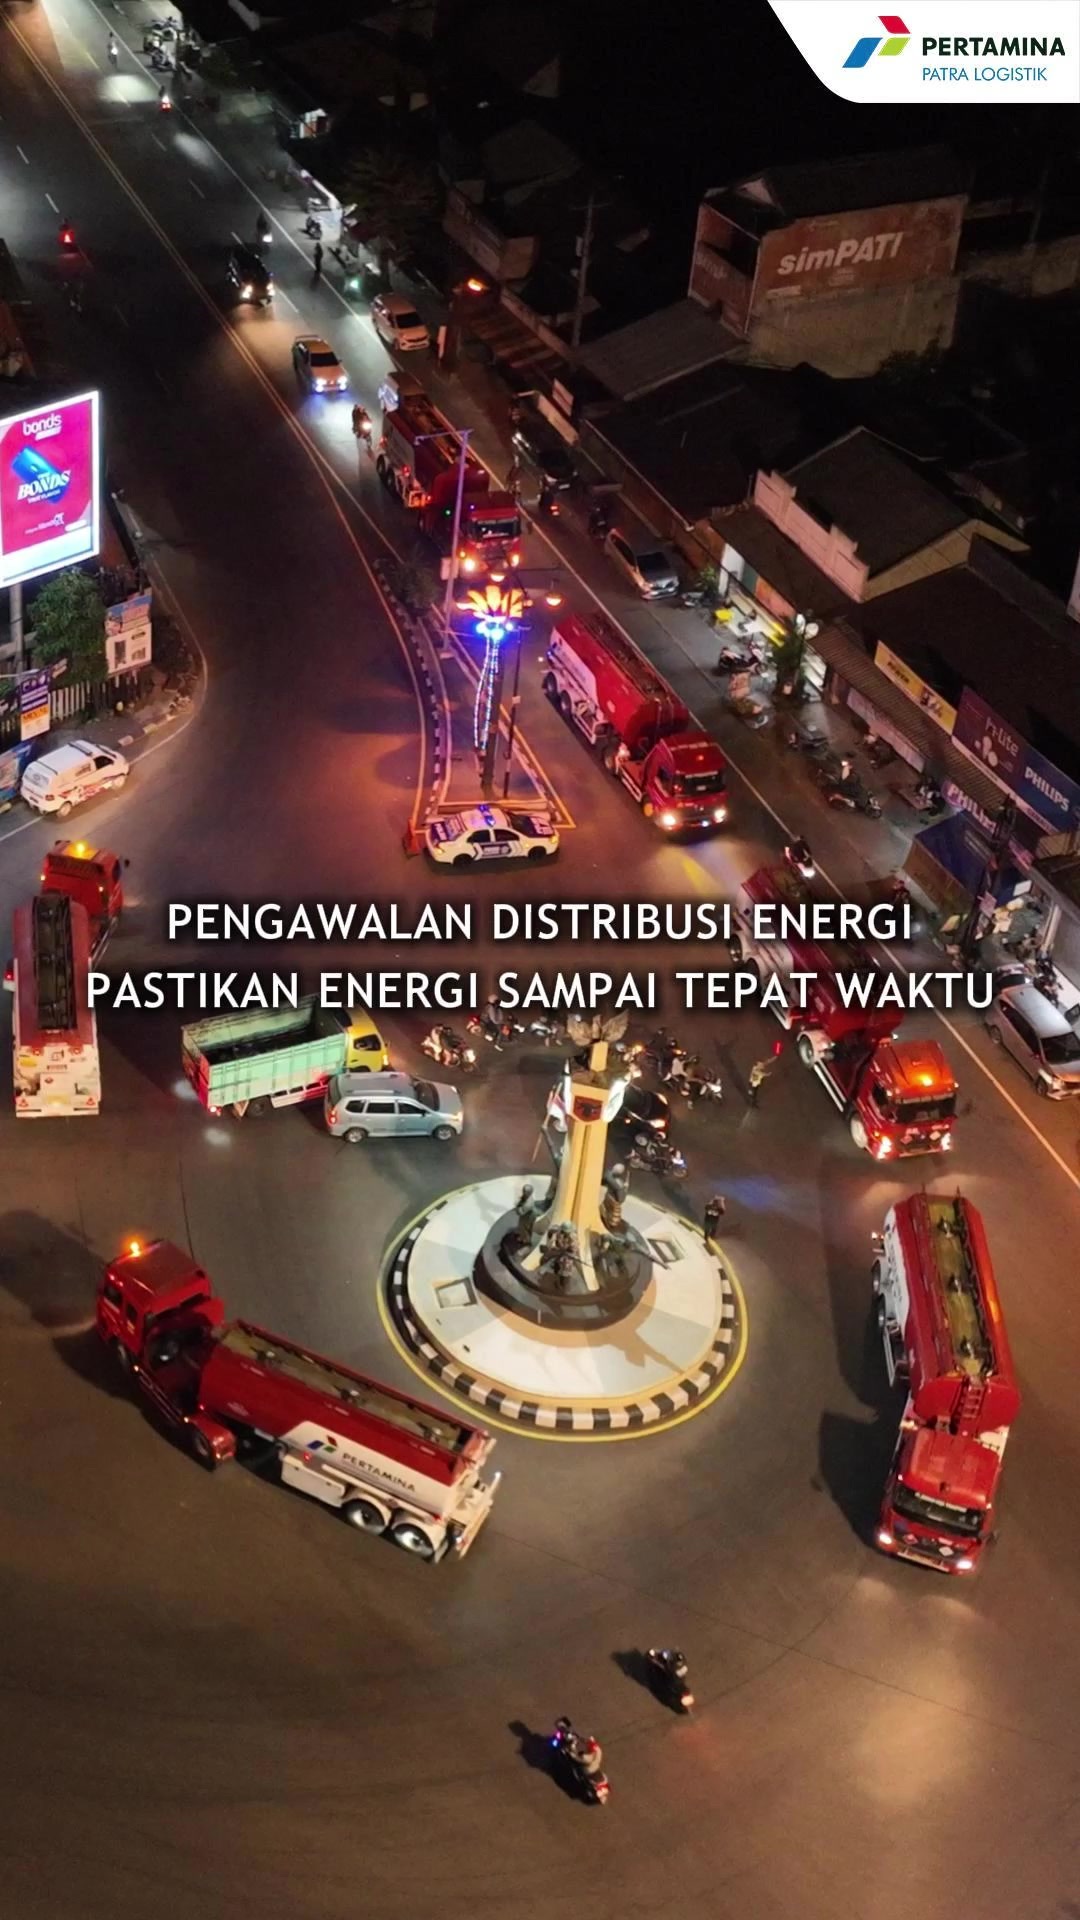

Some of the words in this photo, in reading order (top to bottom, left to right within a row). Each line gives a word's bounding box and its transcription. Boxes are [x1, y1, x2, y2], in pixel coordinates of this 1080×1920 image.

[777, 232, 904, 275] simPATI
[23, 413, 62, 436] bonds
[17, 470, 71, 500] BONDS
[1024, 766, 1069, 811] PHILIPS
[343, 1453, 415, 1491] PERTAMINA
